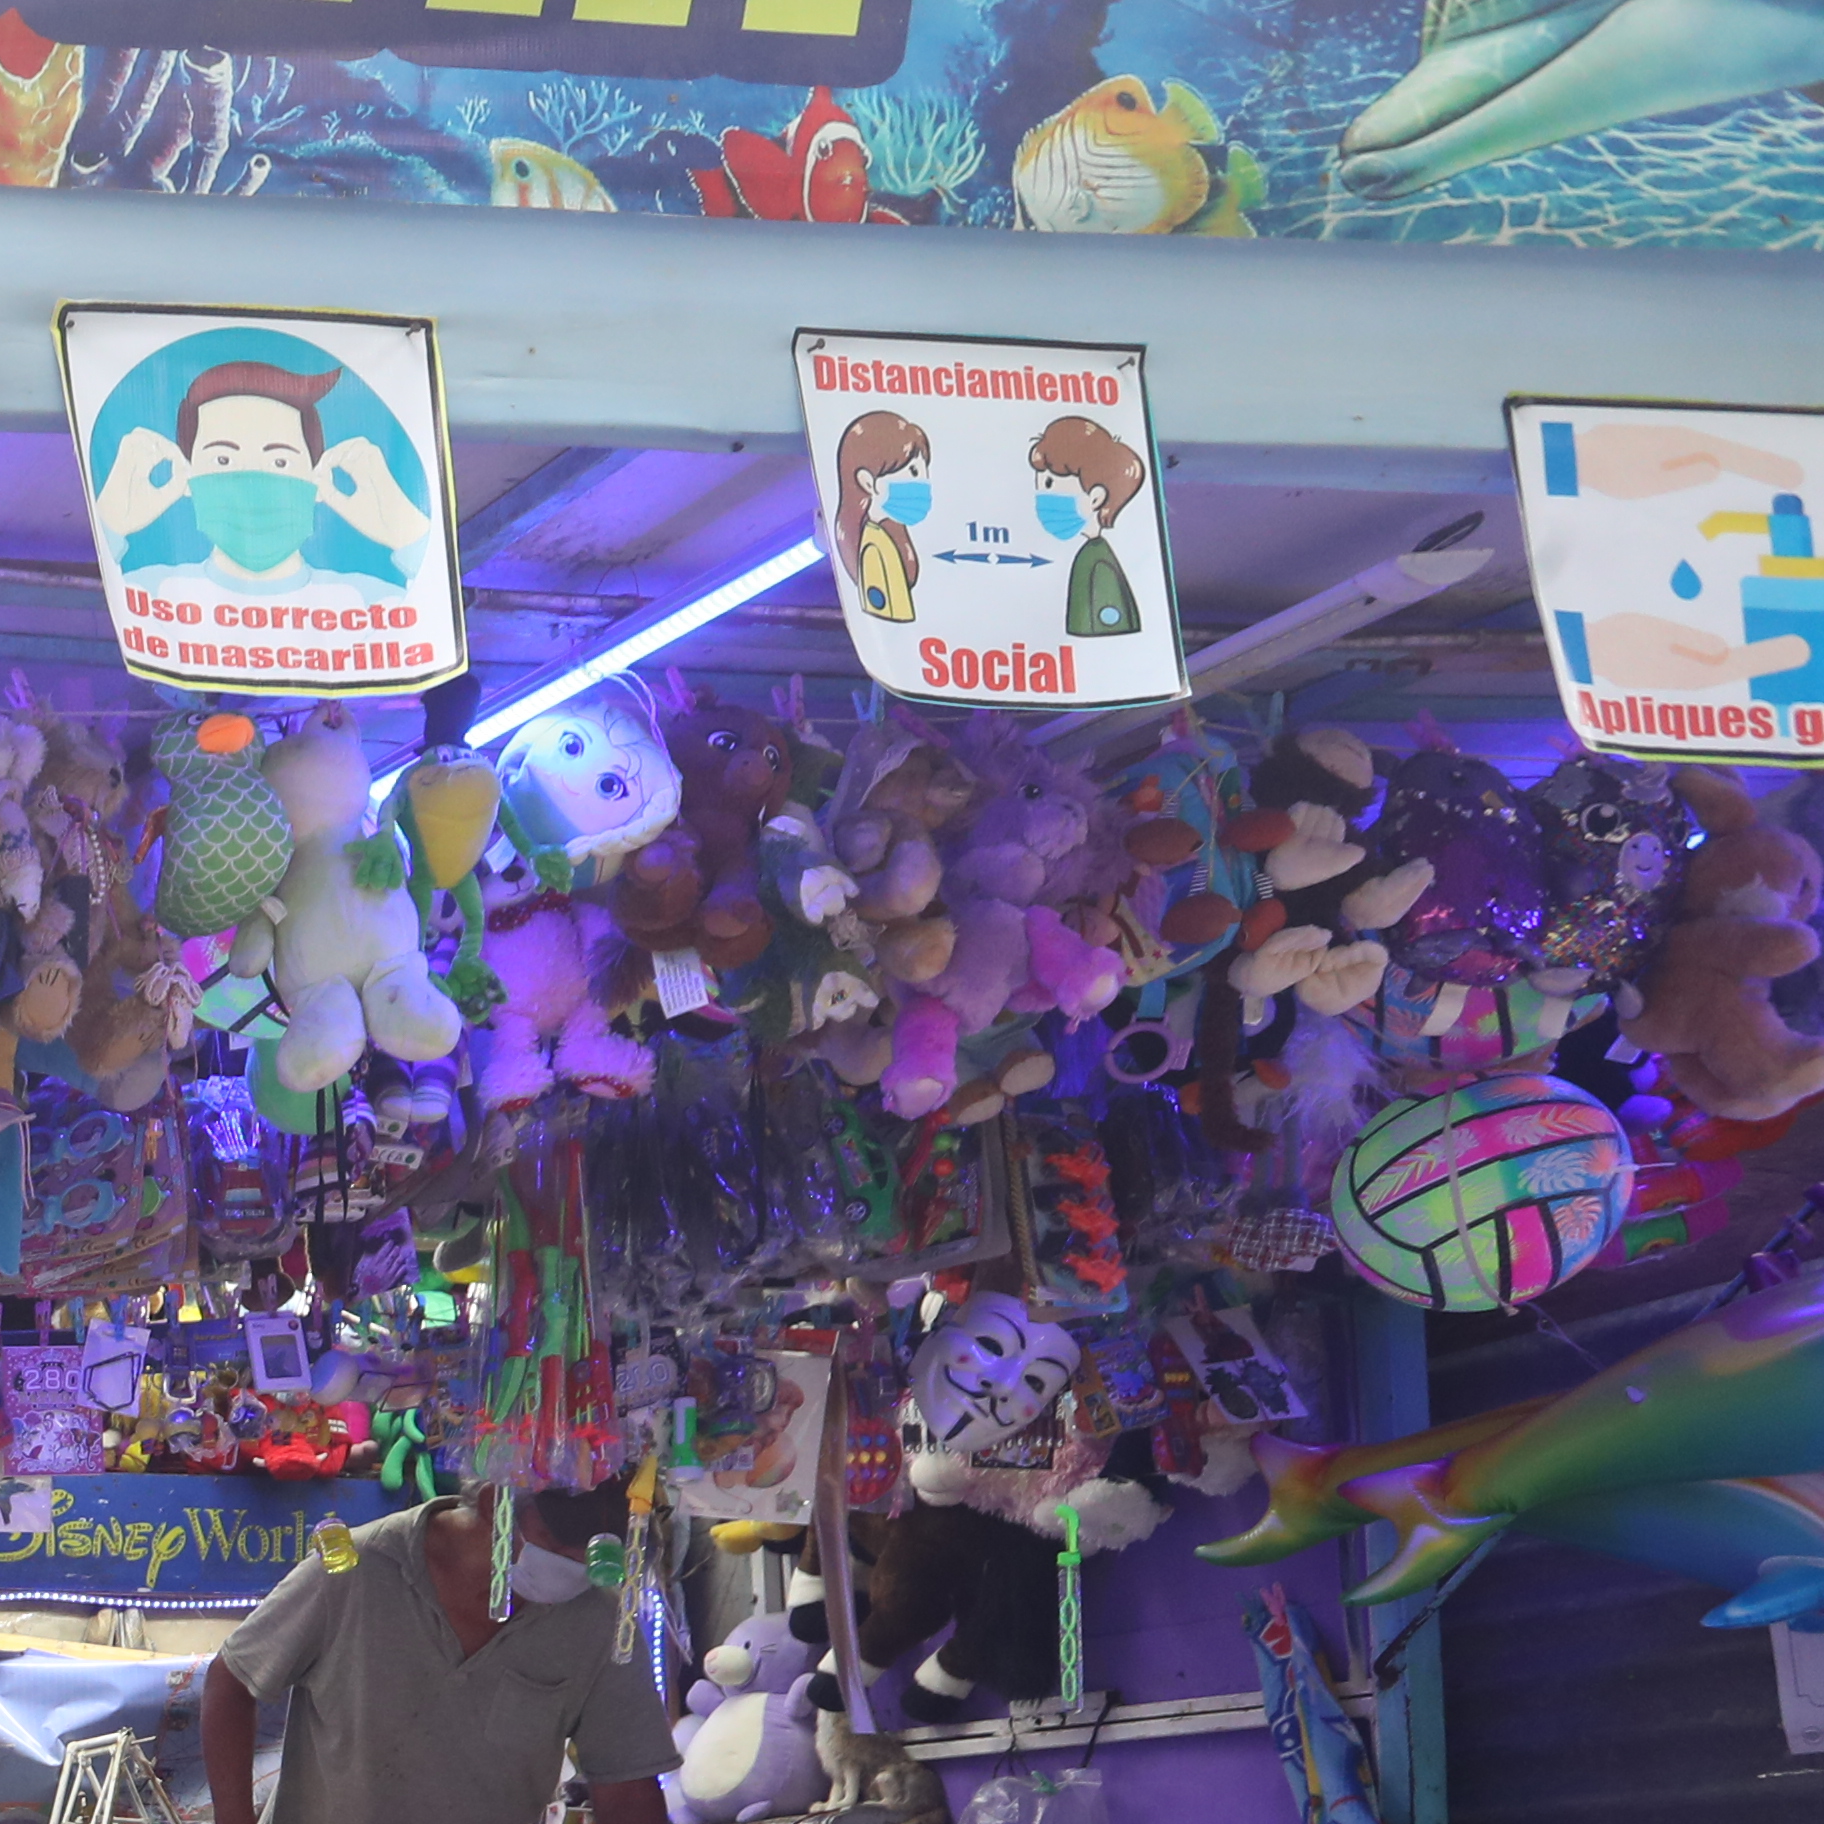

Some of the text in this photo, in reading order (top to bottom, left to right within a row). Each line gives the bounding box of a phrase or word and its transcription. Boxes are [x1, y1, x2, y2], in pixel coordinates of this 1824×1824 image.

[814, 354, 1120, 406] Distanciamiento
[965, 519, 1011, 546] 1m
[126, 588, 418, 631] Uso correcto
[123, 627, 434, 671] de mascarilla
[920, 637, 1076, 693] Social
[1578, 690, 1775, 741] Apliques
[182, 1508, 337, 1564] Worl
